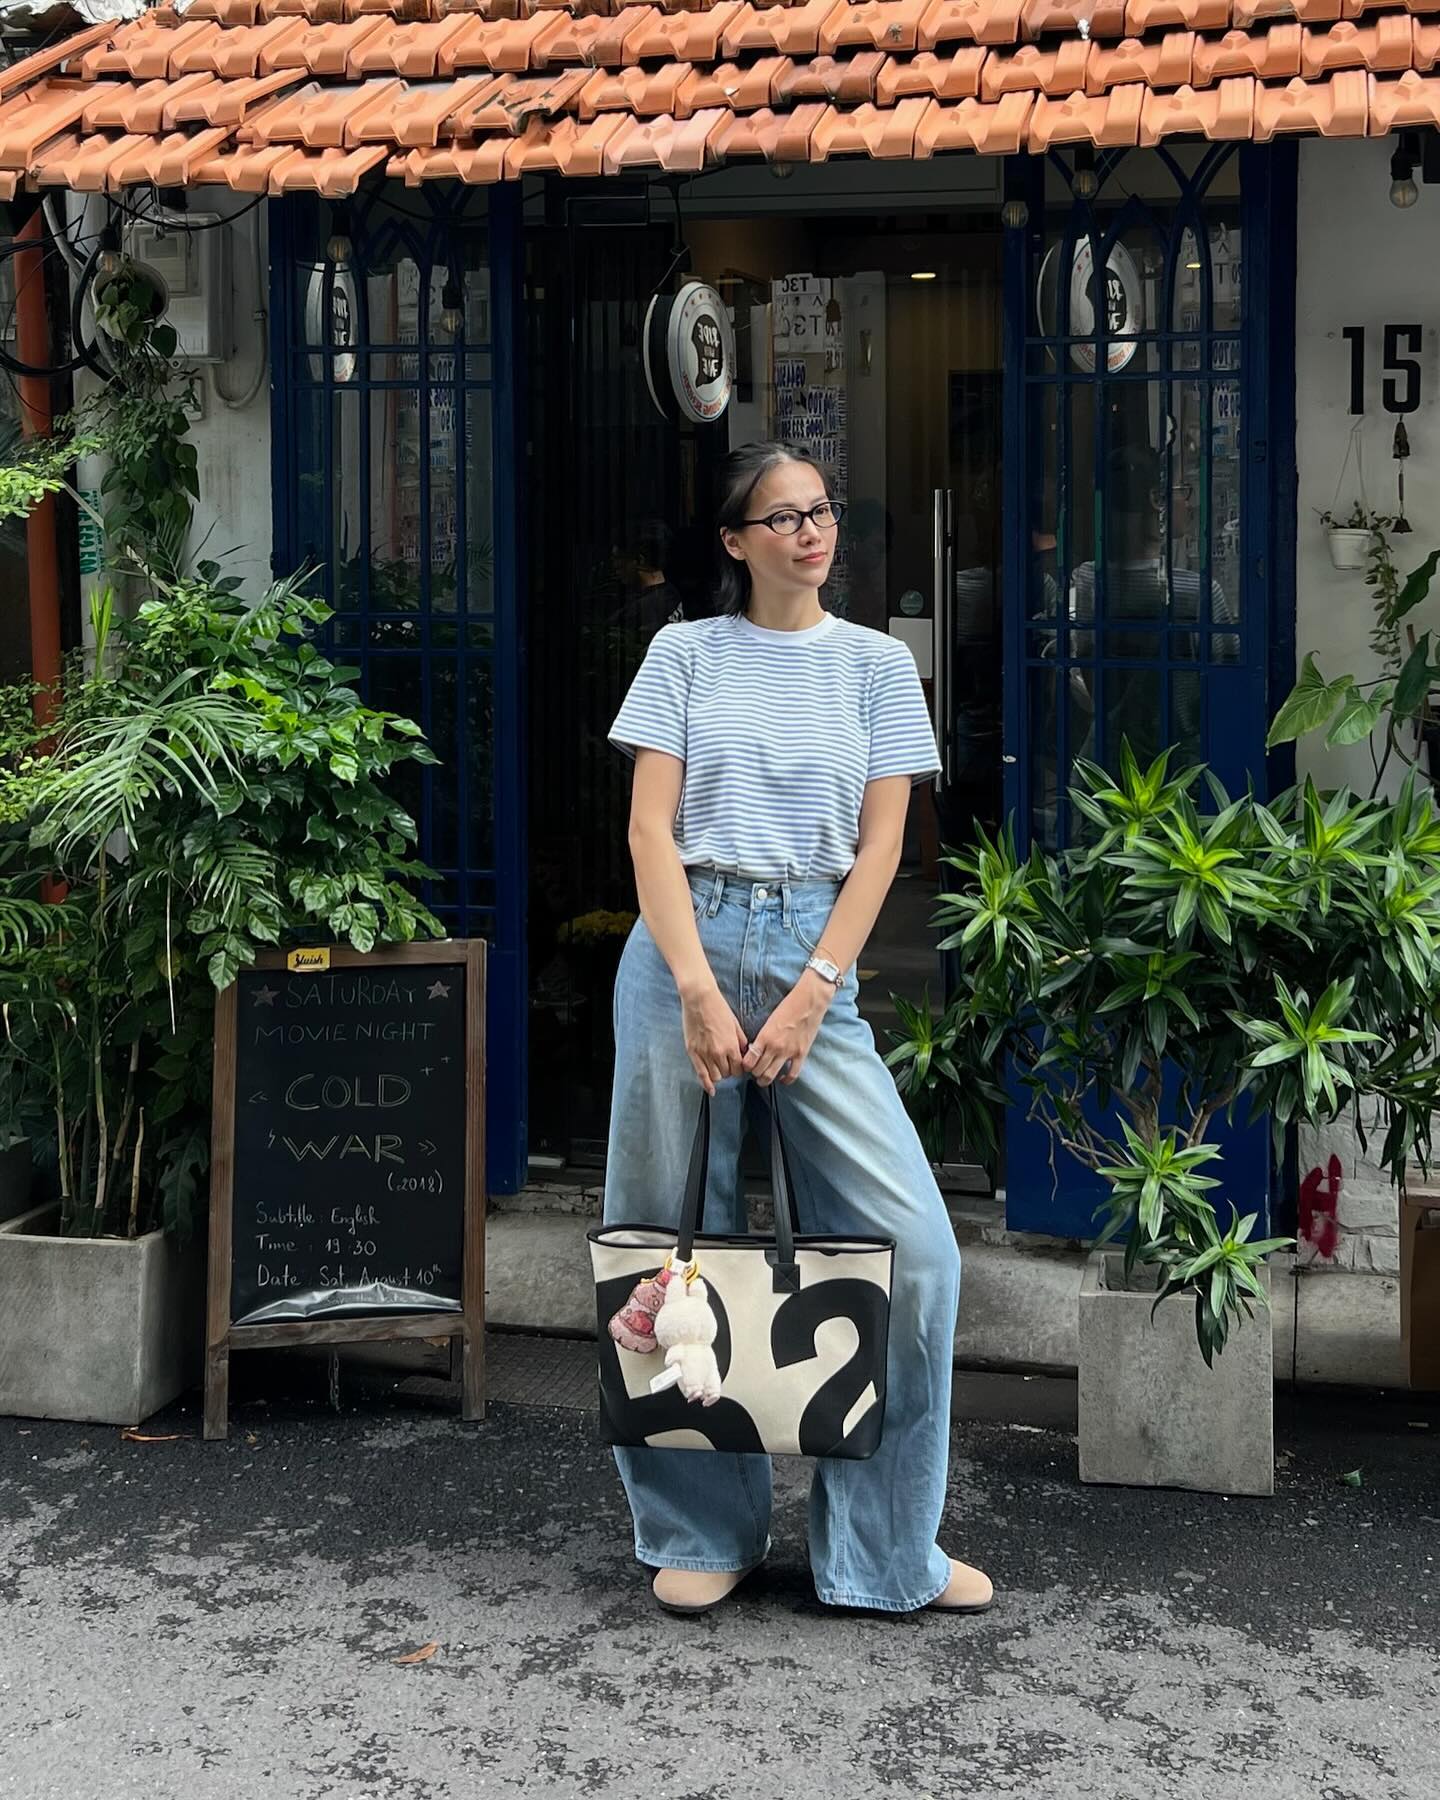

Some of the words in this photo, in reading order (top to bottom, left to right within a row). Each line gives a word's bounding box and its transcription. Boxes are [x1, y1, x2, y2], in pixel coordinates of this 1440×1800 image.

[1342, 323, 1423, 416] 15
[285, 974, 416, 1008] SATURDAY
[254, 1023, 348, 1045] MOVIE
[355, 1021, 436, 1042] NIGHT
[284, 1073, 412, 1111] COLD
[282, 1134, 405, 1165] WAR
